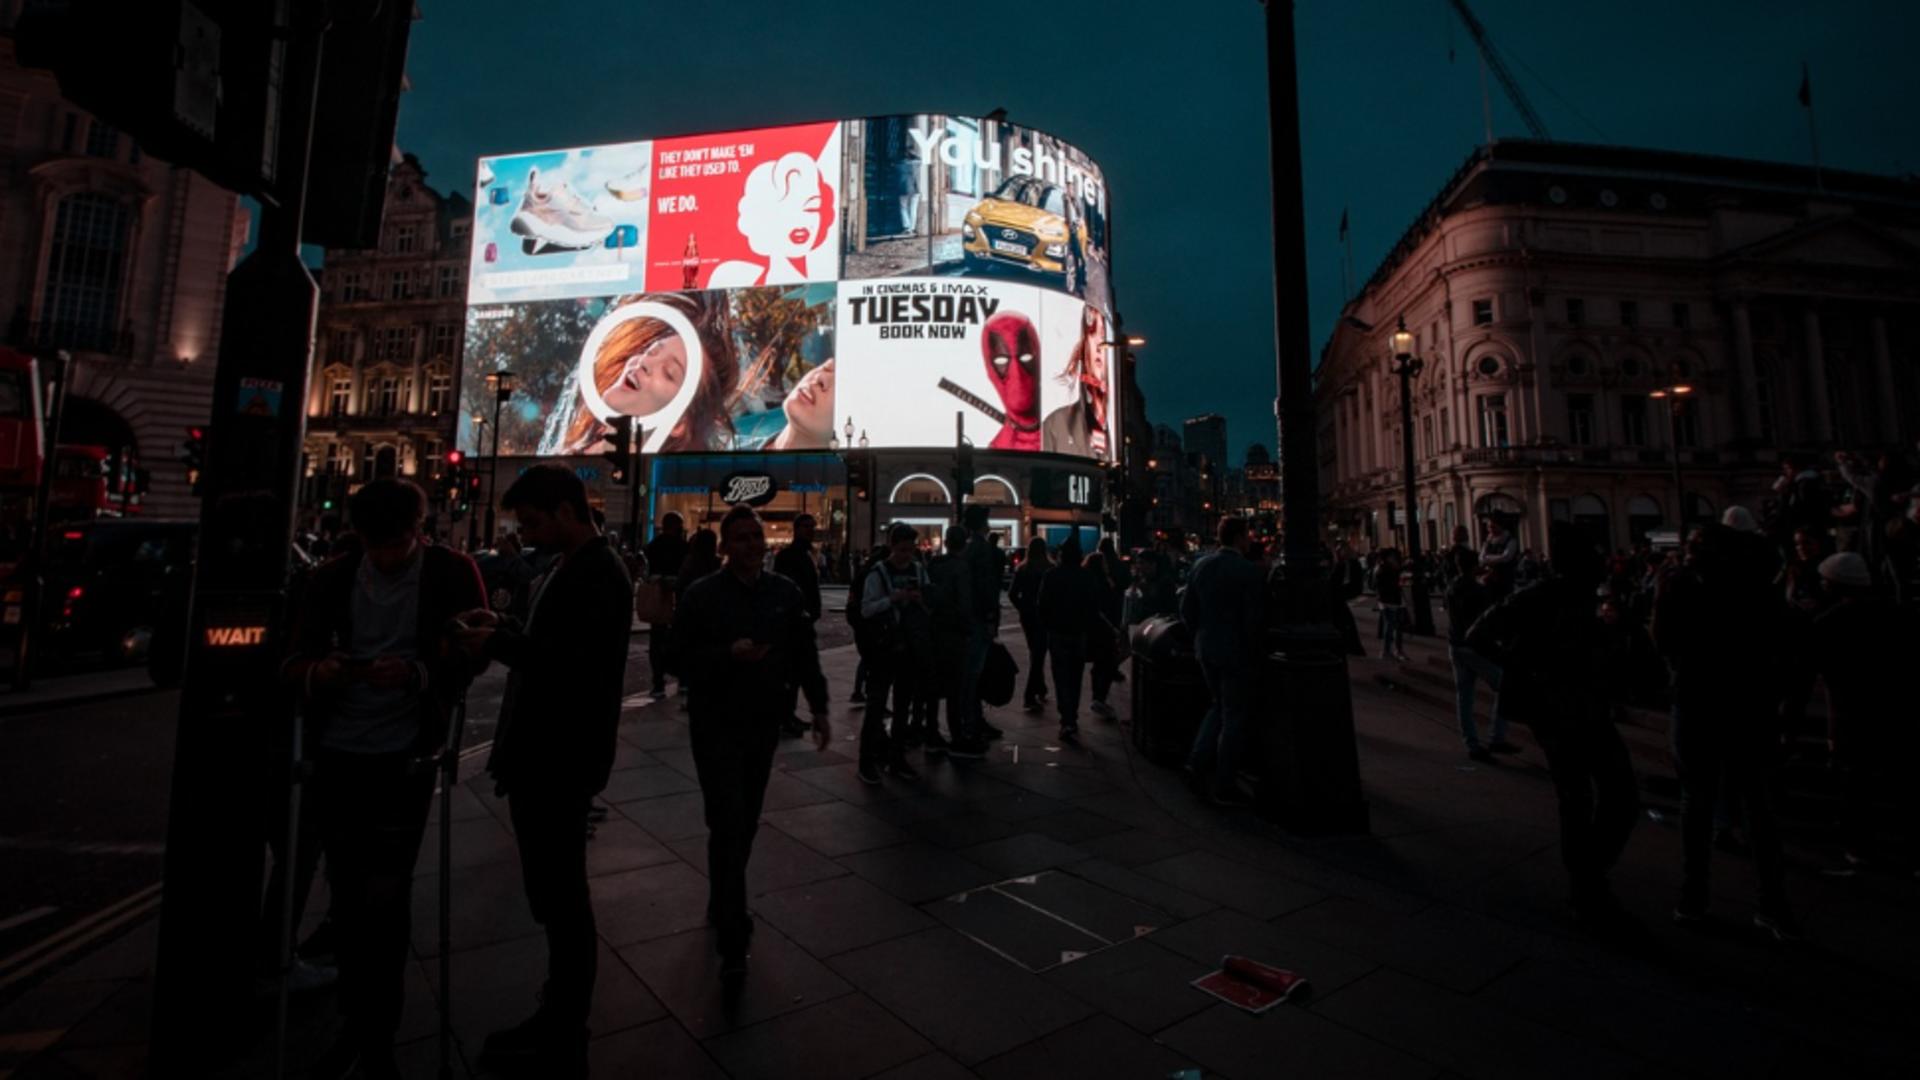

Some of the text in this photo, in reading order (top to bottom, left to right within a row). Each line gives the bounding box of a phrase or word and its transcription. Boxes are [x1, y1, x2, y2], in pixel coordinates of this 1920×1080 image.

[660, 150, 681, 165] THEY
[683, 147, 709, 162] DON'T
[710, 145, 736, 160] MAKE
[908, 128, 1000, 170] You
[659, 160, 741, 180] LIKE THEY USED TO.
[657, 194, 699, 214] WE DO.
[863, 285, 873, 295] IN
[877, 283, 926, 294] CINEMAS
[942, 284, 989, 295] IMAX
[848, 295, 1000, 325] TUESDAY
[880, 325, 966, 339] BOOK NOW
[1069, 474, 1090, 505] GAP
[207, 627, 266, 645] WAIT
